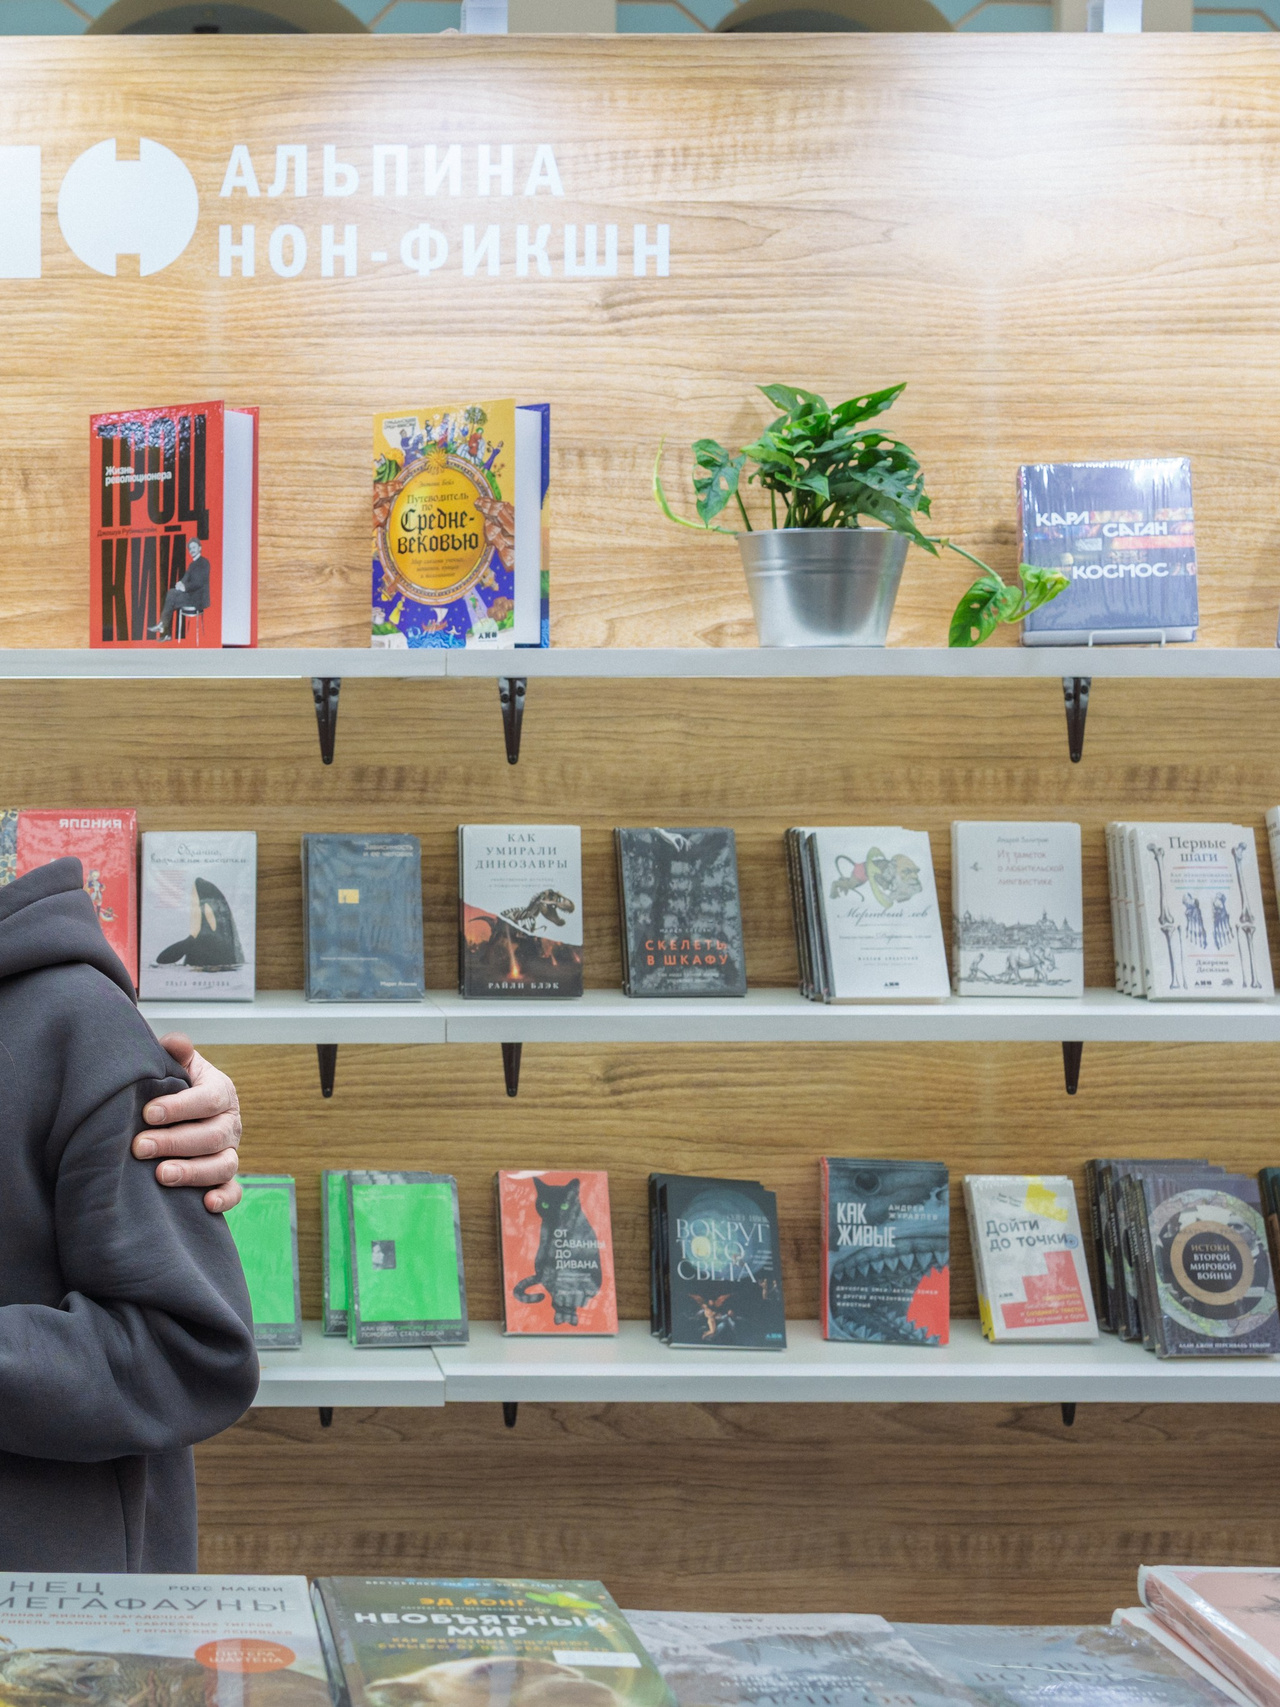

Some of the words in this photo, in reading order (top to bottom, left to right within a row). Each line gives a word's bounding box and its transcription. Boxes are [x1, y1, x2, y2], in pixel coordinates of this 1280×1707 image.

[218, 143, 565, 197] АЛЬПИНА
[218, 223, 671, 277] НОН-ФИКШН
[97, 414, 210, 540] ТРОЦ
[105, 466, 135, 476] Жизнь
[105, 471, 172, 487] революционера
[407, 492, 469, 506] Путеводитель
[422, 503, 433, 511] по
[400, 508, 475, 535] Средне-
[1036, 511, 1089, 527] КАРЛ
[1102, 522, 1168, 537] САГАН
[397, 533, 479, 555] вековью
[1073, 562, 1169, 580] КОСМОС
[101, 525, 187, 642] КИЙ
[507, 833, 536, 843] КАК
[1169, 836, 1227, 852] Первые
[486, 846, 558, 856] УМИРАЛИ
[1180, 853, 1219, 863] шаги
[475, 859, 569, 870] ДИНОЗАВРЫ
[646, 955, 655, 966] В
[663, 954, 728, 966] ШКАФУ
[488, 981, 525, 990] РАЙЛИ
[530, 982, 560, 990] БЛЭК
[836, 1202, 867, 1224] КАК
[888, 1212, 939, 1220] ЖУРАВЛЕВ
[554, 1229, 568, 1238] ОТ
[676, 1218, 770, 1246] ВОКРУГ
[986, 1218, 1040, 1237] Дойти
[836, 1224, 896, 1248] ЖИВЫЕ
[989, 1238, 1011, 1253] до
[1015, 1233, 1069, 1248] точки
[554, 1239, 606, 1249] САВАННЫ
[676, 1238, 745, 1260] ТОГО
[1190, 1244, 1230, 1252] ИСТОКИ
[555, 1249, 572, 1259] ДО
[1193, 1252, 1231, 1261] ВТОРОЙ
[555, 1260, 598, 1269] ДИВАНА
[677, 1260, 757, 1283] СВЕТА
[1190, 1261, 1237, 1271] МИРОВОЙ
[1196, 1271, 1233, 1280] ВОЙНЫ
[419, 1597, 454, 1607] ЭД
[463, 1597, 527, 1608] ЙОНГ
[353, 1611, 608, 1628] НЕОБЪЯТНЫЙ
[446, 1625, 528, 1637] МИР
